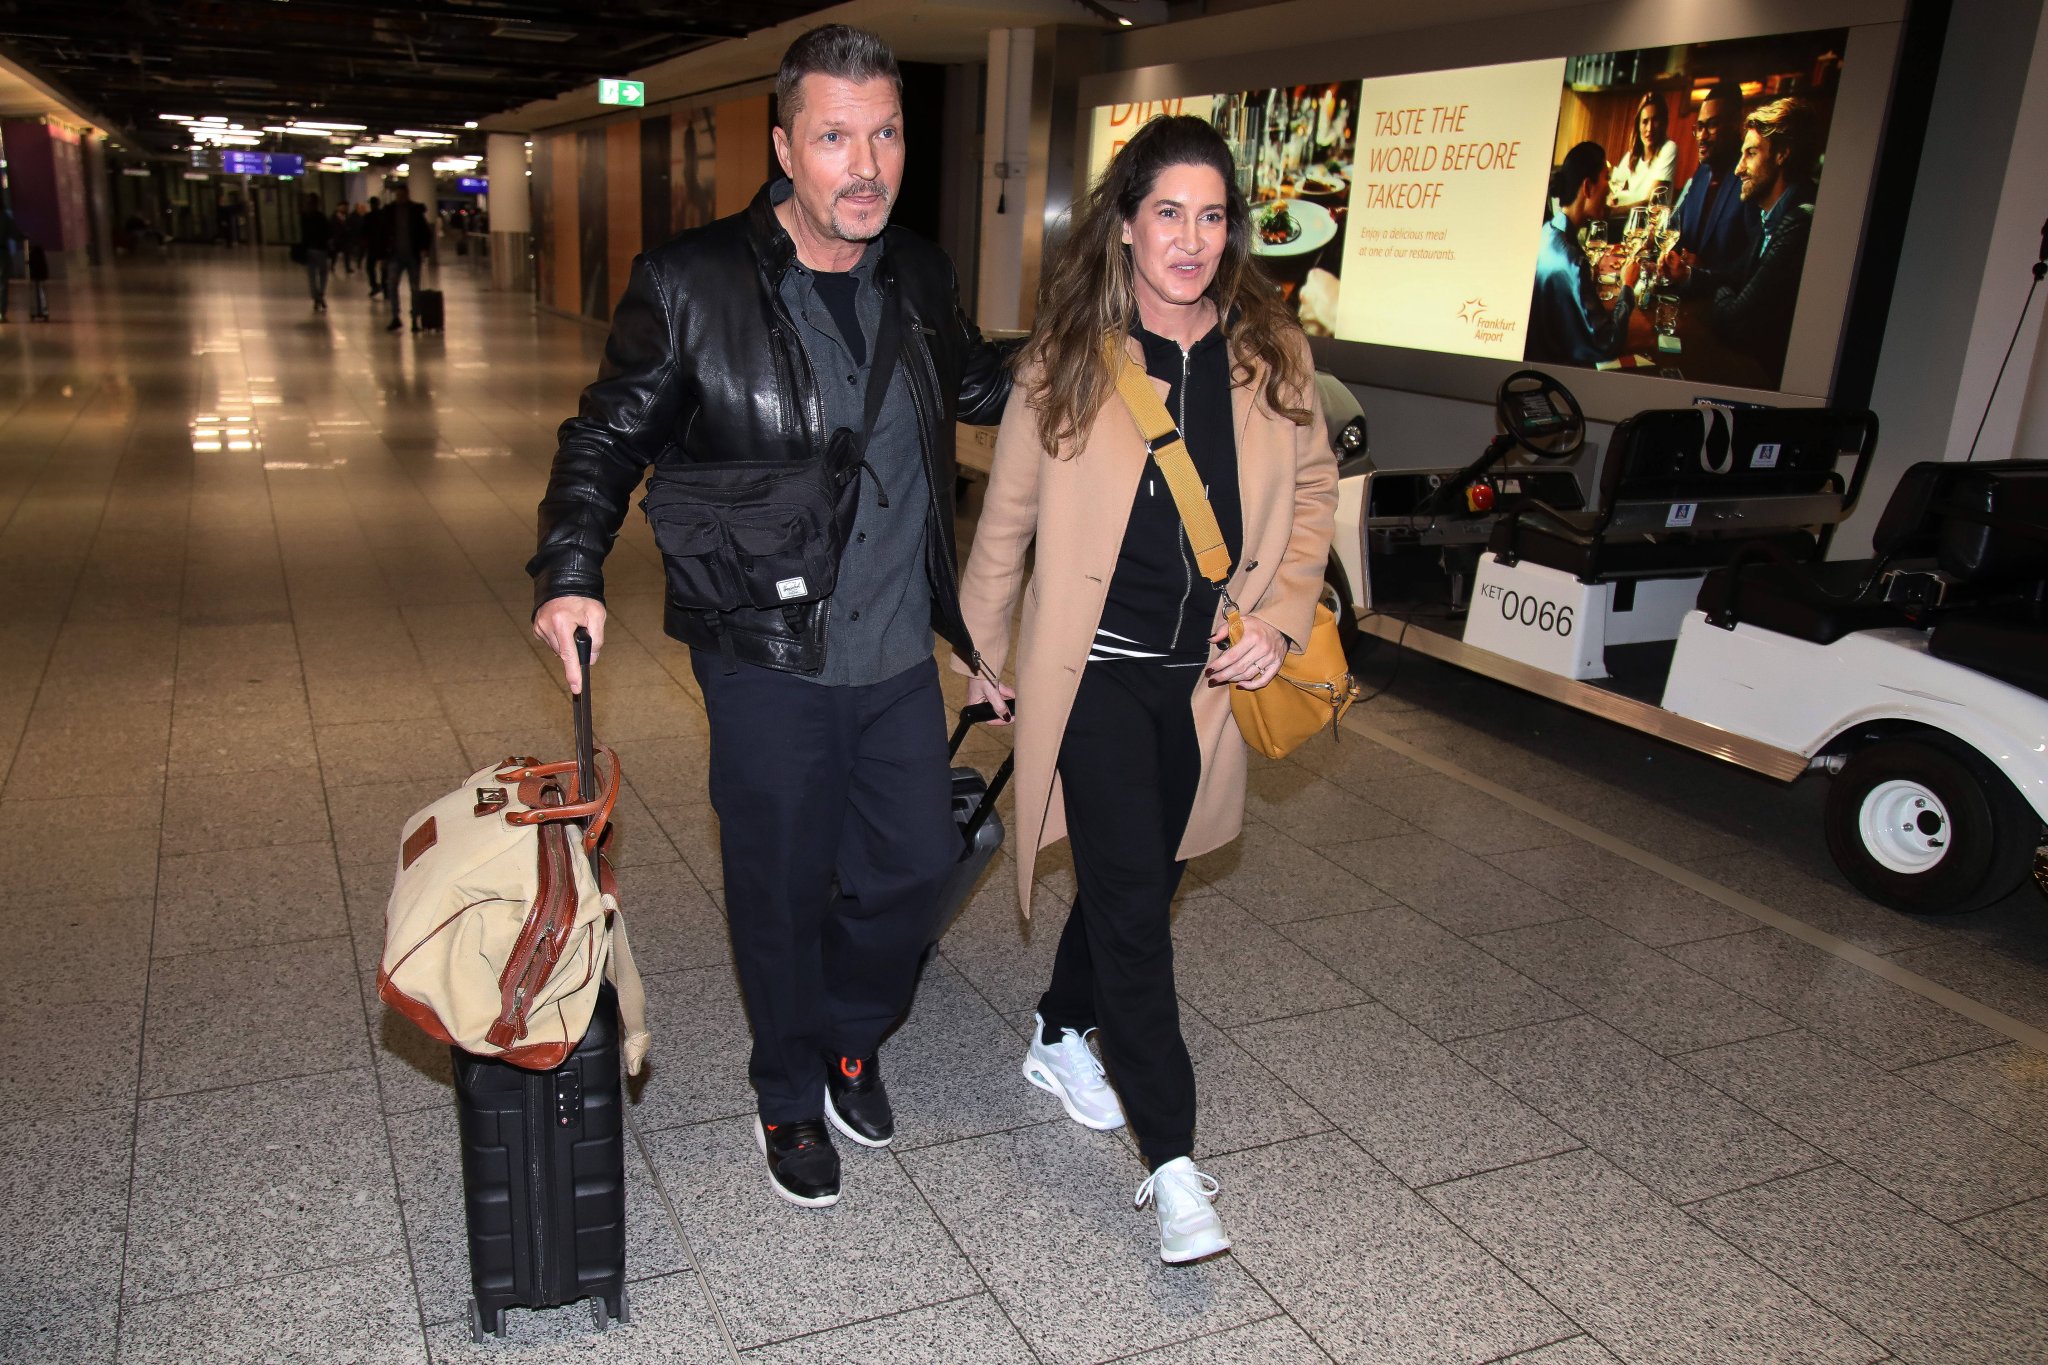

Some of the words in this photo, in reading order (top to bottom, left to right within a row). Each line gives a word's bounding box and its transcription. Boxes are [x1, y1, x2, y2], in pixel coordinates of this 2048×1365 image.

[1376, 109, 1426, 136] TASTE
[1431, 105, 1469, 133] THE
[1370, 146, 1438, 172] WORLD
[1441, 142, 1521, 171] BEFORE
[1366, 183, 1444, 208] TAKEOFF
[1361, 227, 1380, 241] Enjoy
[1382, 230, 1389, 239] a
[1389, 228, 1424, 240] delicious
[1425, 229, 1448, 240] meal
[1359, 246, 1368, 256] at
[1368, 247, 1383, 257] one
[1384, 246, 1394, 258] of
[1394, 248, 1408, 258] our
[1409, 248, 1456, 261] restaurants.
[1477, 317, 1516, 331] Frankfurt
[1474, 329, 1504, 343] Airport
[1481, 583, 1504, 600] KET
[1501, 590, 1574, 637] 0066
